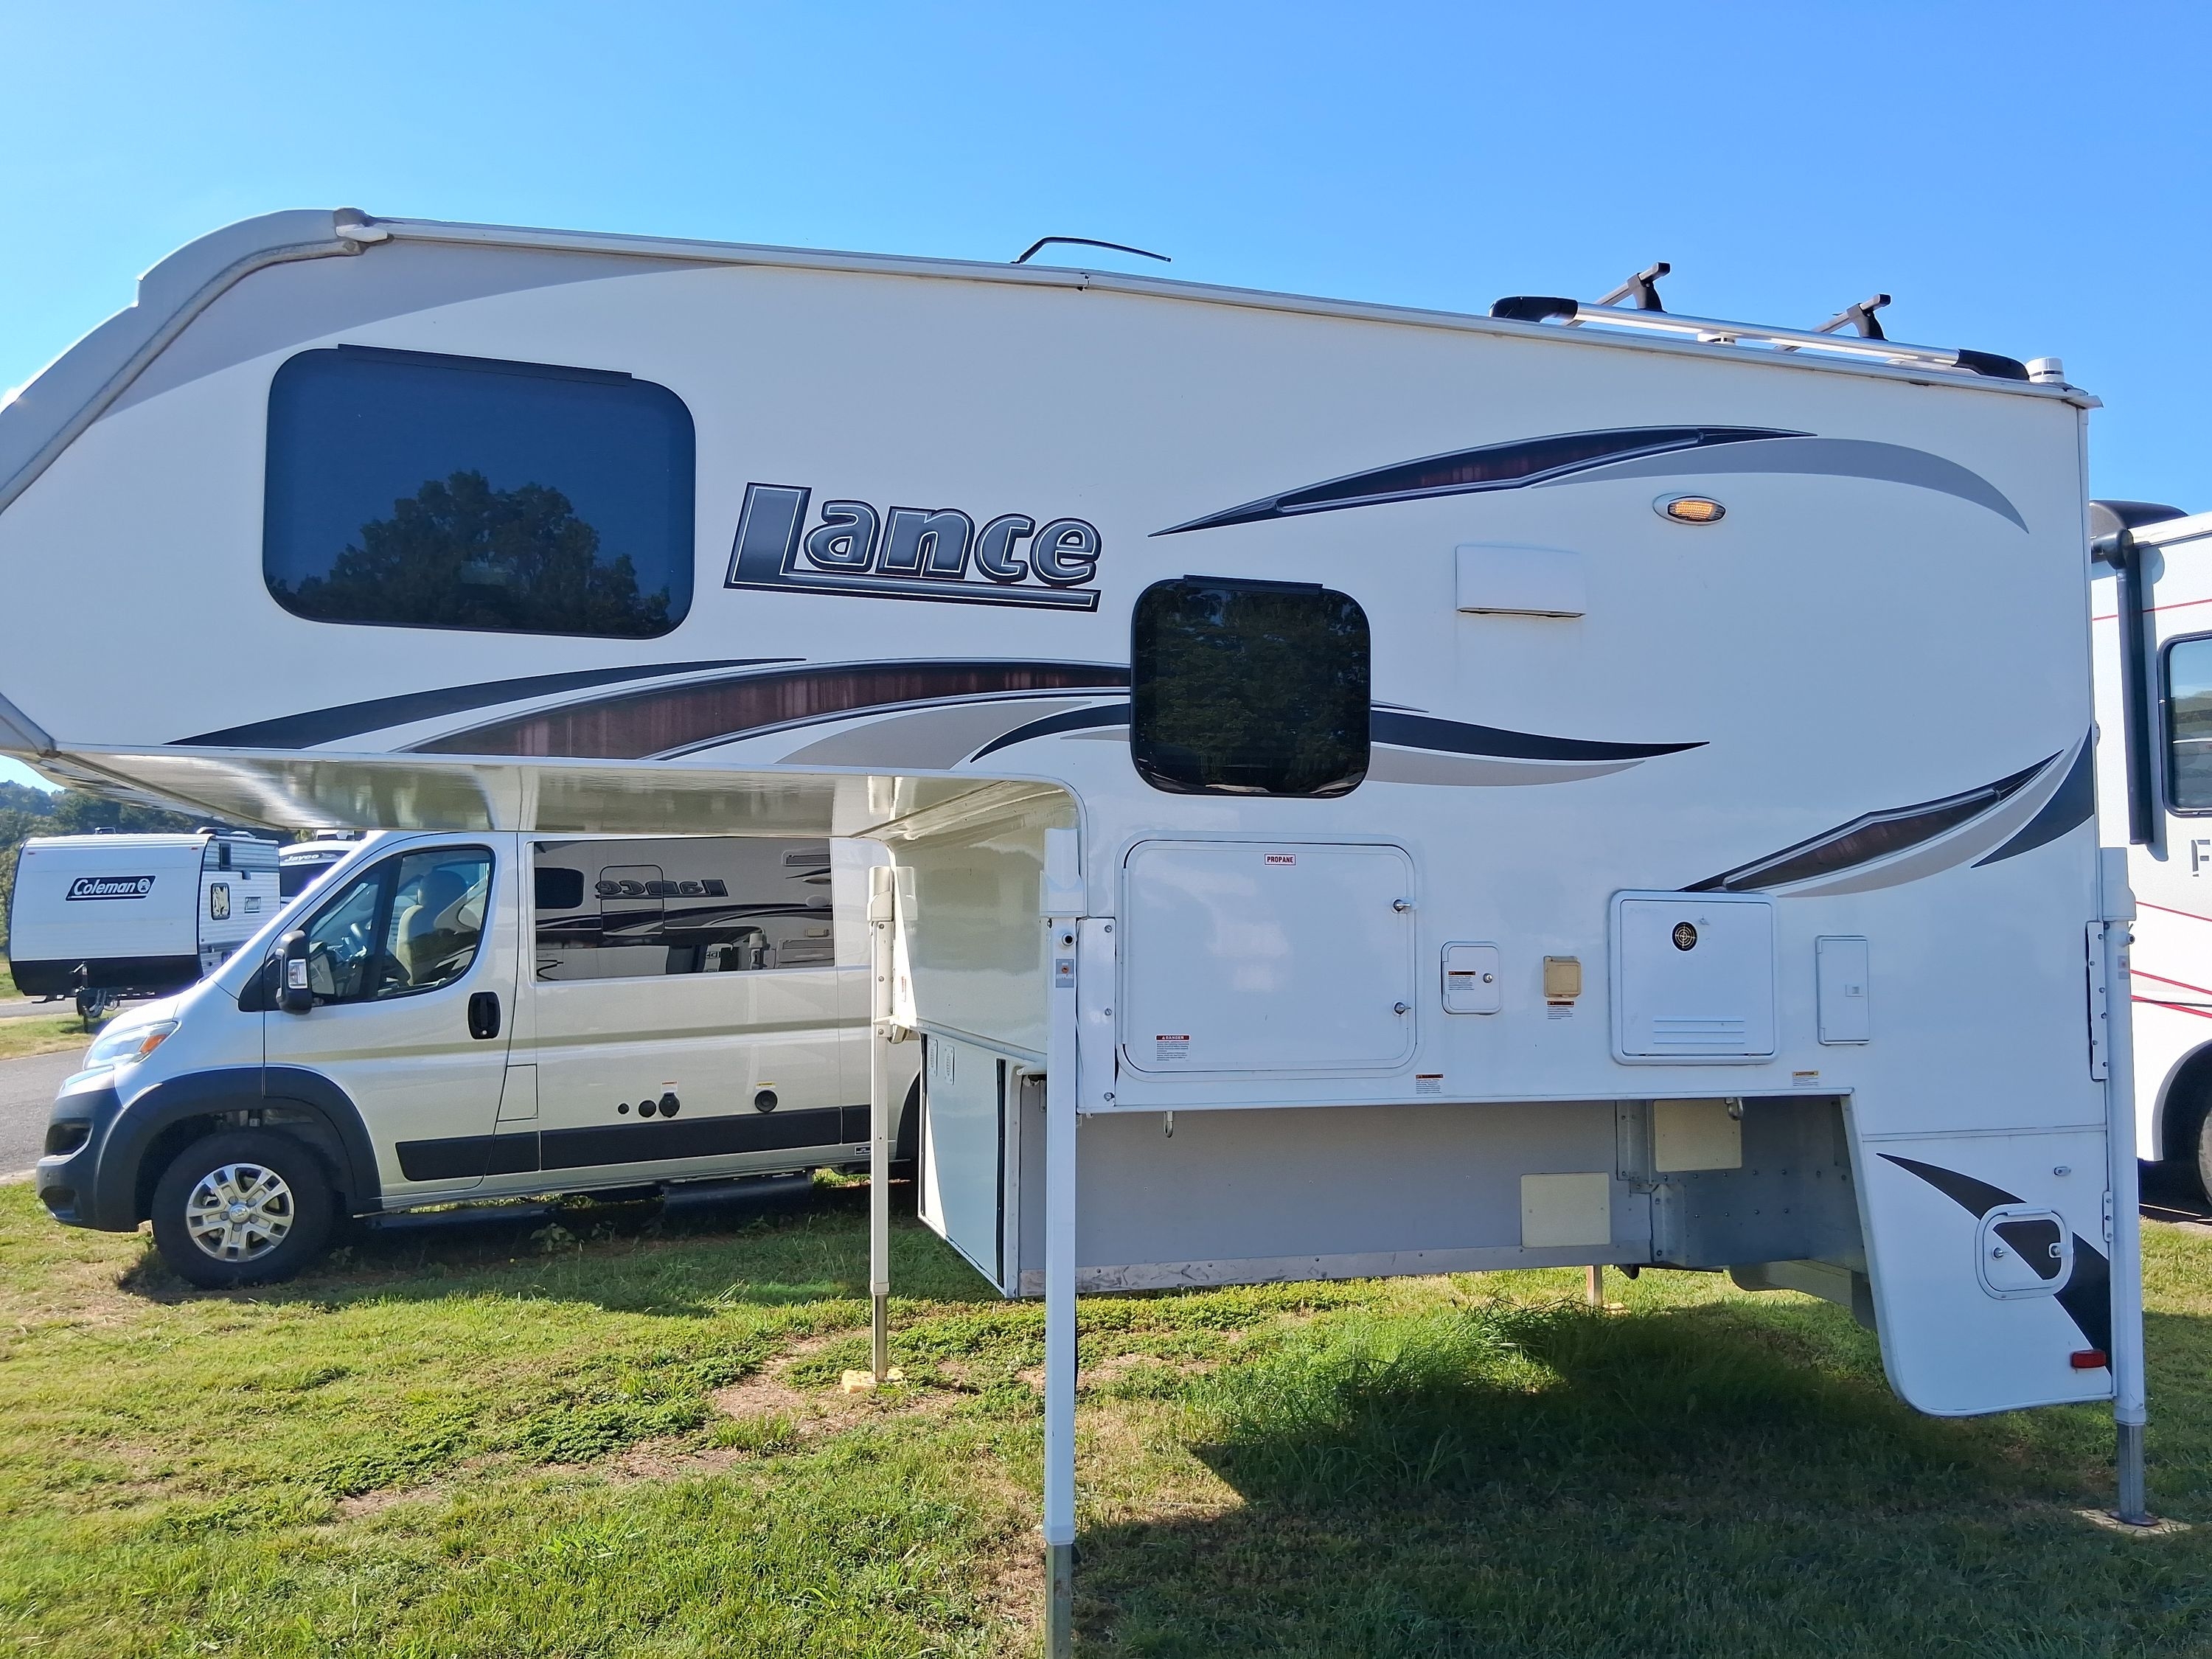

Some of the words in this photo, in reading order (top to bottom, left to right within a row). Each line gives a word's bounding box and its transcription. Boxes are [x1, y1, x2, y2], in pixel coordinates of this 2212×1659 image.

[723, 481, 1102, 613] Lance
[284, 854, 319, 862] Jayco
[74, 879, 136, 895] Coleman
